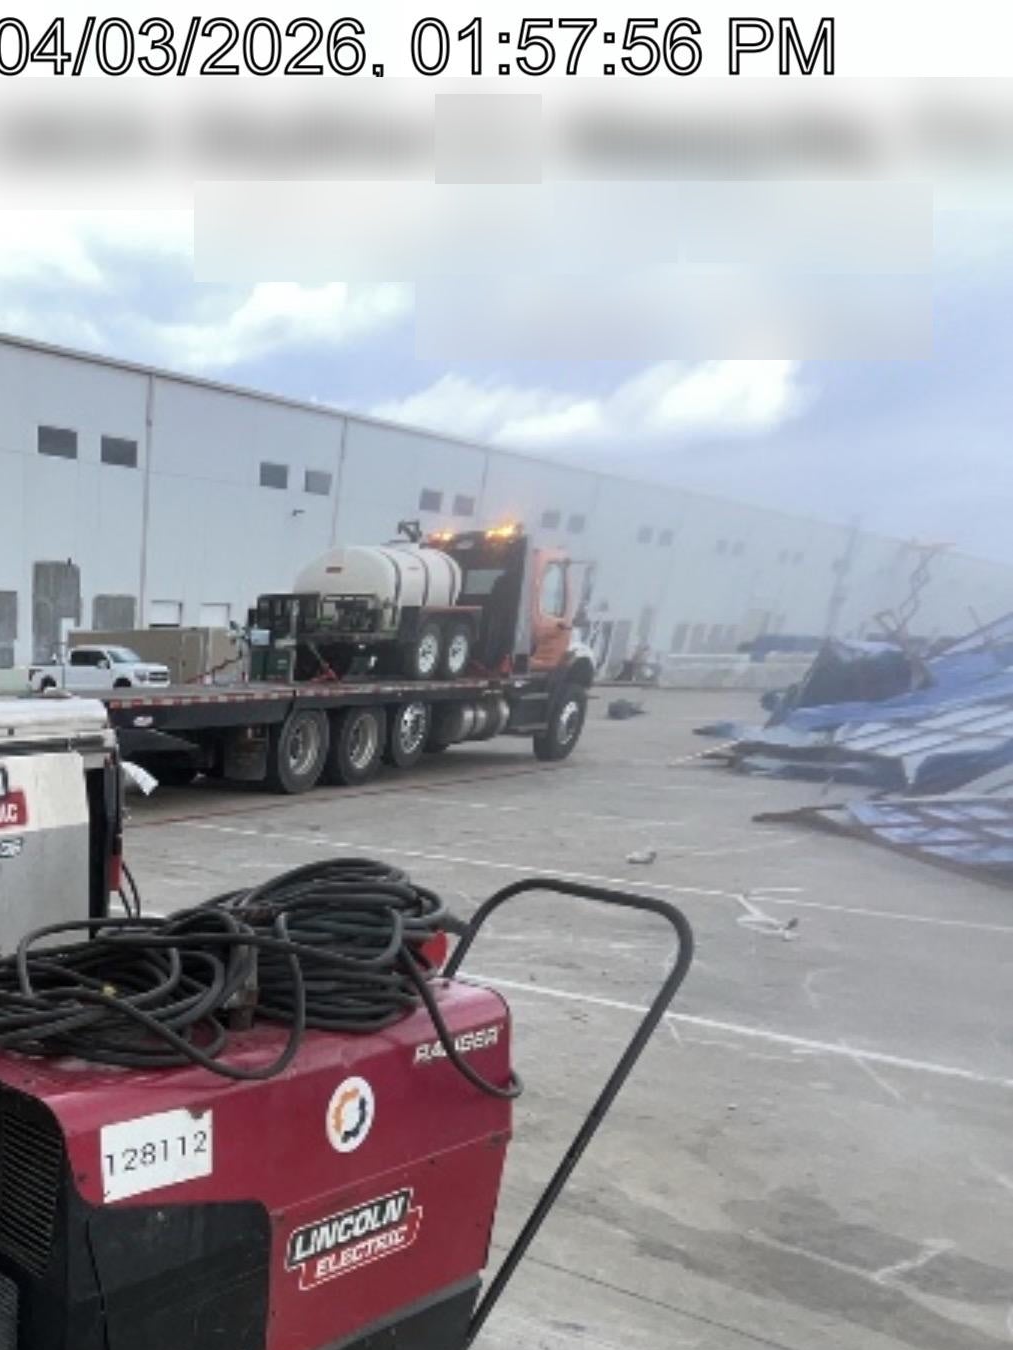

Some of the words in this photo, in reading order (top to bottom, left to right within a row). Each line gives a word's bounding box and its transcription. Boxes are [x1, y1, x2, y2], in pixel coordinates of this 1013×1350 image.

[412, 1026, 498, 1066] RAGER
[104, 1130, 207, 1176] 128112
[293, 1196, 405, 1261] LINCOLN
[315, 1225, 408, 1278] ELECTRIC
